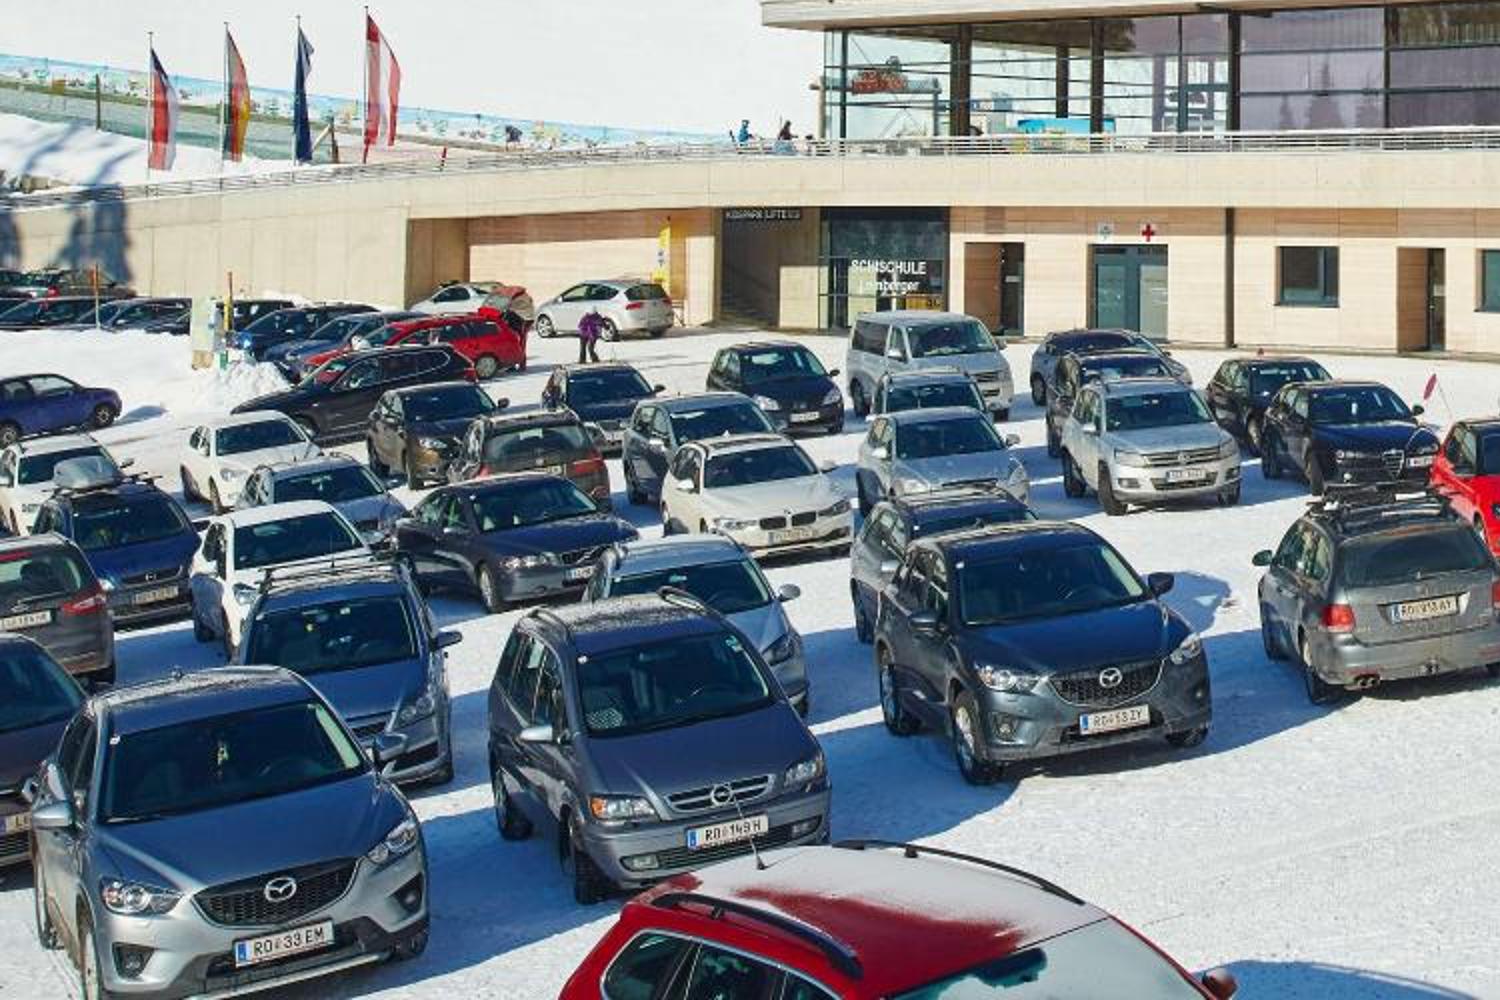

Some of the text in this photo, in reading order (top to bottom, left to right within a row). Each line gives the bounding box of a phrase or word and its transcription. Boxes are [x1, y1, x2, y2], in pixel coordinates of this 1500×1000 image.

[851, 259, 927, 275] SCHISCHULE
[254, 939, 273, 955] RO
[305, 927, 324, 944] EM
